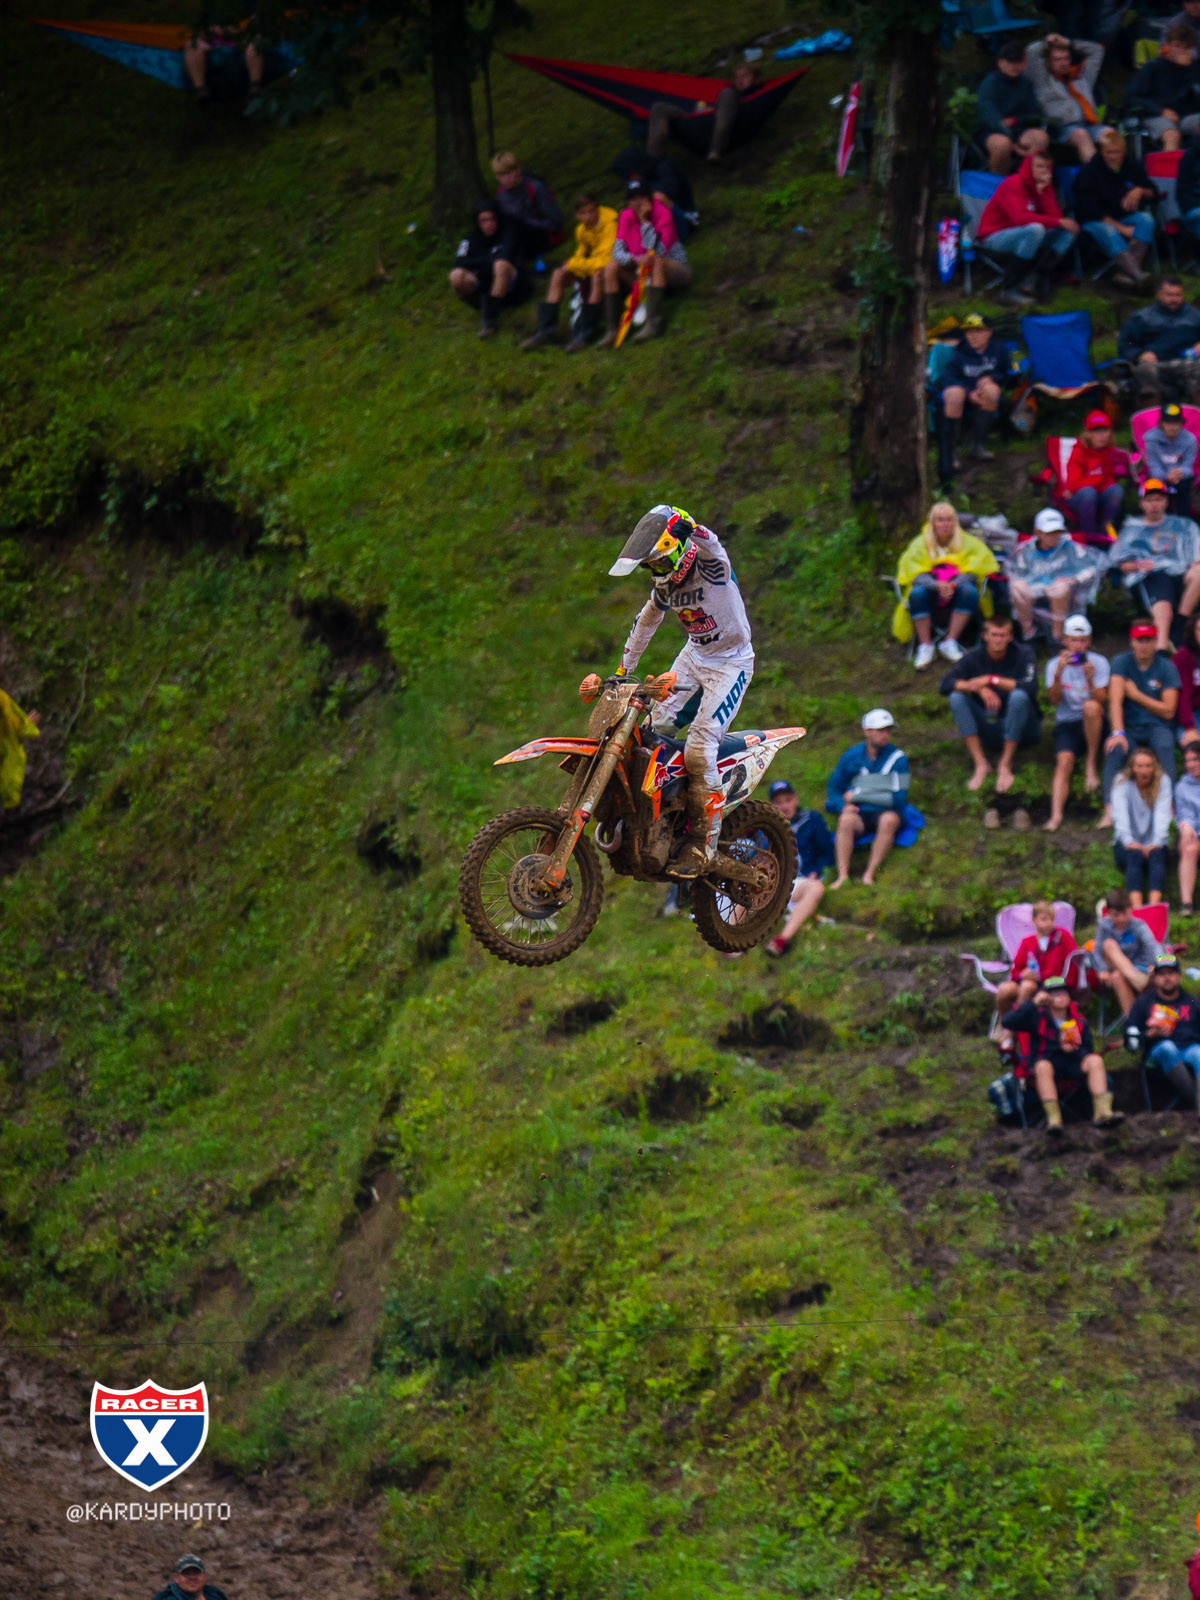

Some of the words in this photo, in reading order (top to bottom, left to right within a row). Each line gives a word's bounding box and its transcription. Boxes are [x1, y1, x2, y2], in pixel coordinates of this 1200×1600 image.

[669, 586, 704, 607] HOR
[712, 670, 748, 726] THOR
[722, 763, 749, 806] 2
